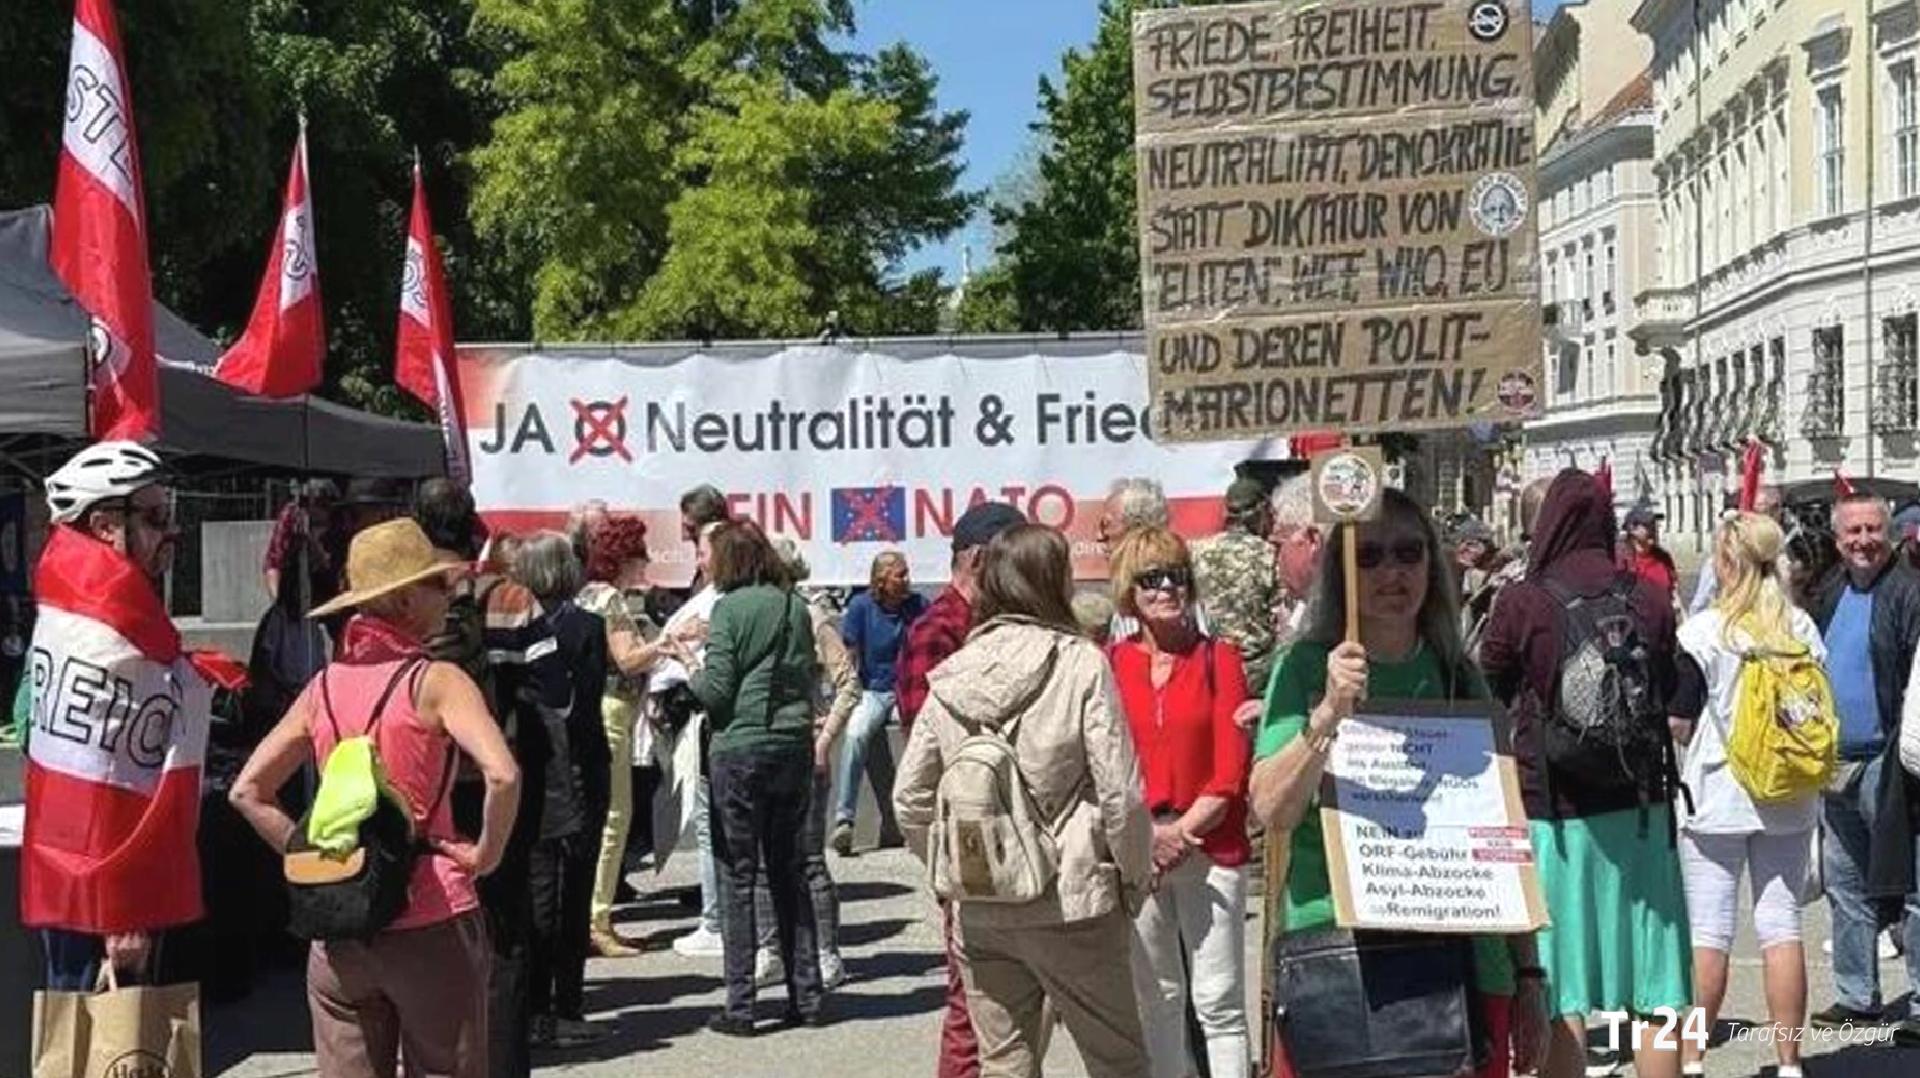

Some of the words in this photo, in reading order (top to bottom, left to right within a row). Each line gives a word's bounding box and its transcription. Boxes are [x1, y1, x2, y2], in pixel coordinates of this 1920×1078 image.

[66, 64, 132, 185] ST
[1148, 201, 1244, 253] STATT
[1245, 193, 1388, 249] DIKTATUR
[1401, 189, 1464, 235] VON
[1460, 239, 1509, 294] EU
[1159, 328, 1221, 375] UND
[1233, 321, 1343, 370] DEREN
[1362, 311, 1491, 364] POLIT-
[480, 401, 556, 453] JA
[646, 394, 954, 453] Neutralität
[976, 394, 1015, 447] &
[1164, 367, 1487, 431] MARIONETTEN!
[682, 491, 812, 541] EIN
[33, 647, 183, 767] REIC
[1356, 824, 1400, 840] NEIN
[1362, 862, 1494, 881] Klima-Abzocke
[1365, 881, 1487, 899] Asyl-Abzocke
